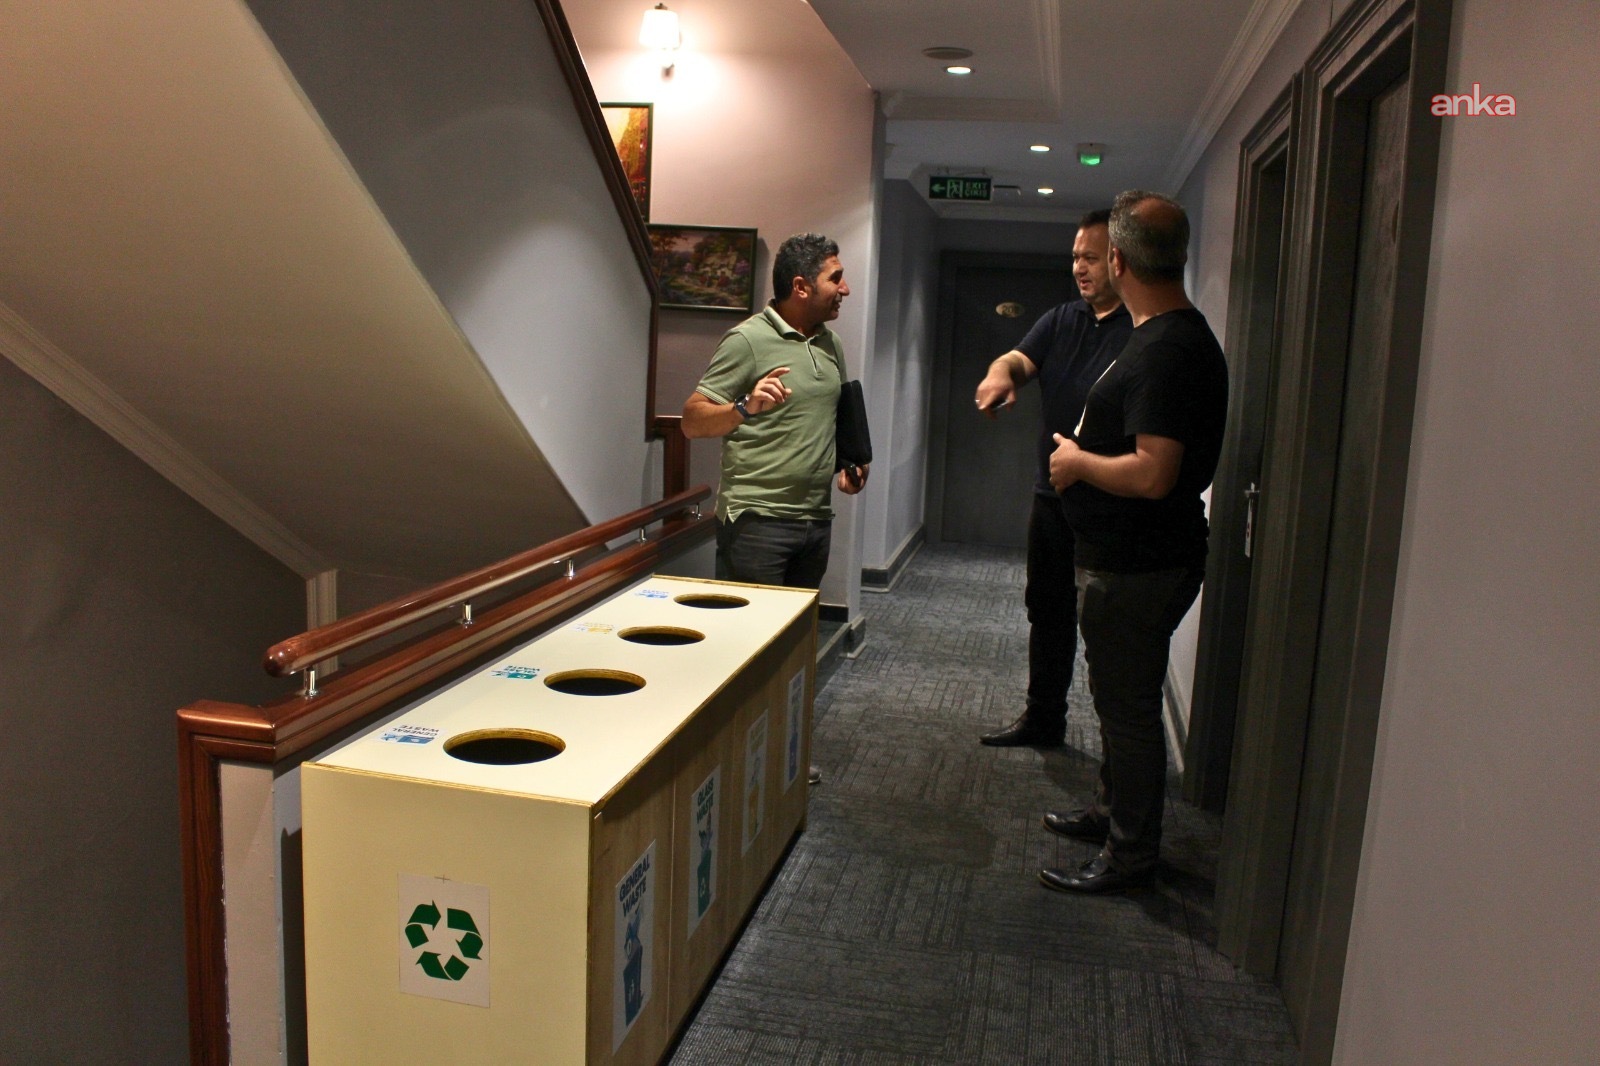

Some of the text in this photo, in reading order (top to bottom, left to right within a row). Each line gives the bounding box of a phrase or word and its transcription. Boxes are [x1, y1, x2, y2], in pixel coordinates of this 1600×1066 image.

[965, 181, 987, 190] EXIT
[392, 727, 438, 736] GENERAL
[400, 724, 440, 733] WASTE
[697, 777, 714, 807] GLASS
[696, 792, 714, 825] WASTE
[619, 853, 650, 902] GENERAL
[622, 875, 647, 917] WASTE
